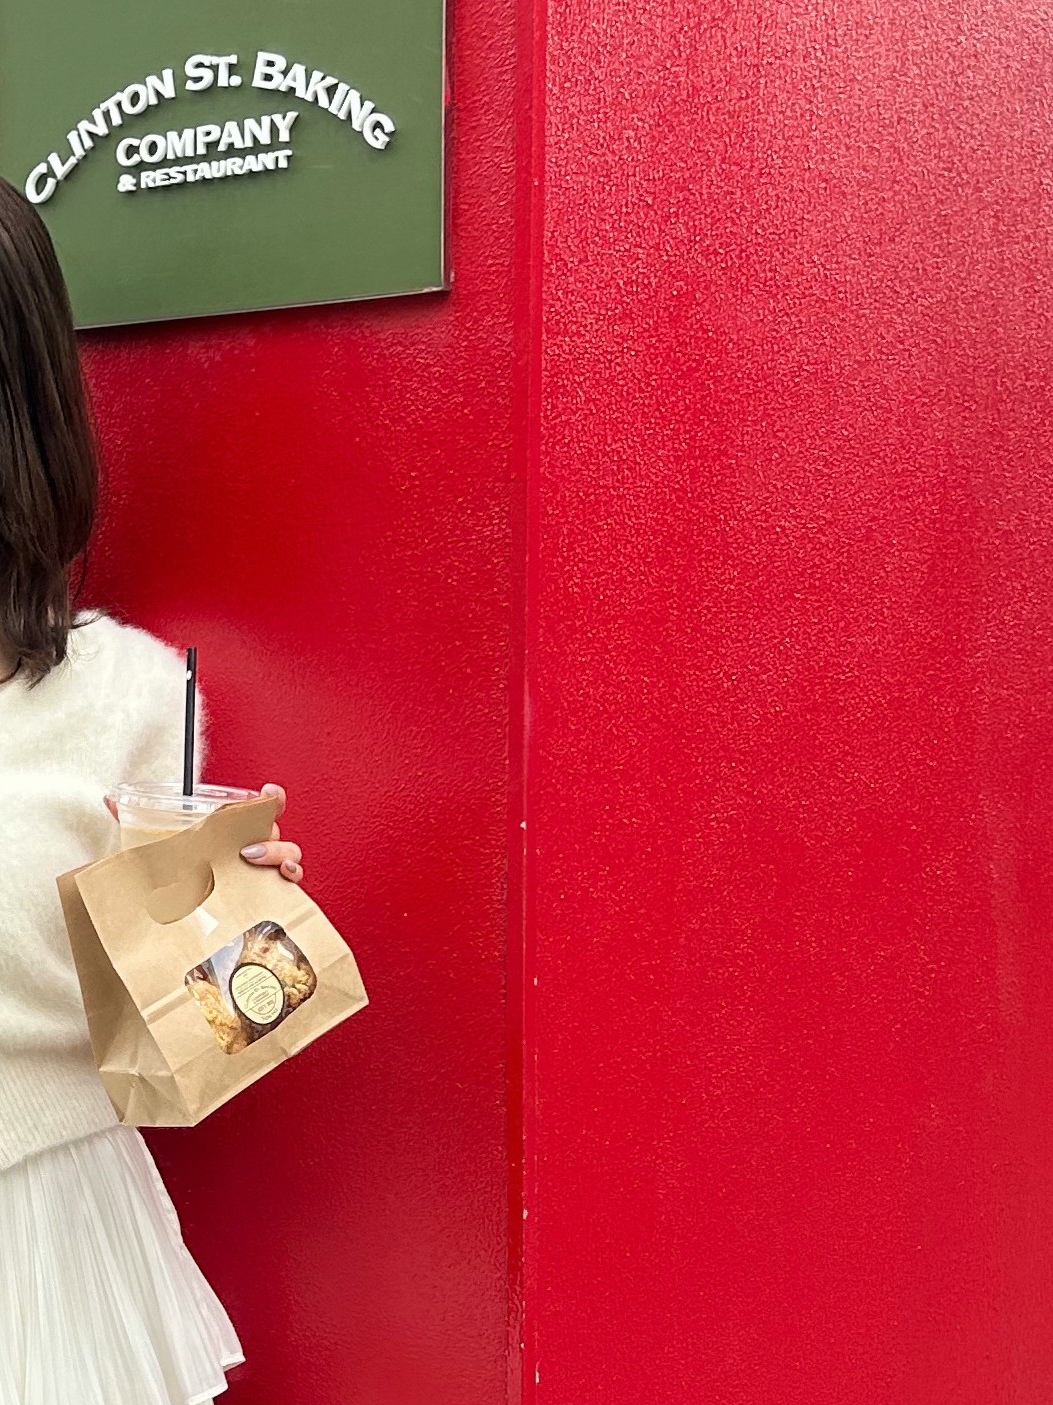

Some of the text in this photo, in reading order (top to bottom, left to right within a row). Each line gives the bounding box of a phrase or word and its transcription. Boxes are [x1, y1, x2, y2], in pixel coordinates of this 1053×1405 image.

[24, 51, 397, 205] CLINTON ST. BAKING
[115, 111, 299, 168] COMPANY
[116, 149, 293, 193] & RESTAURANT
